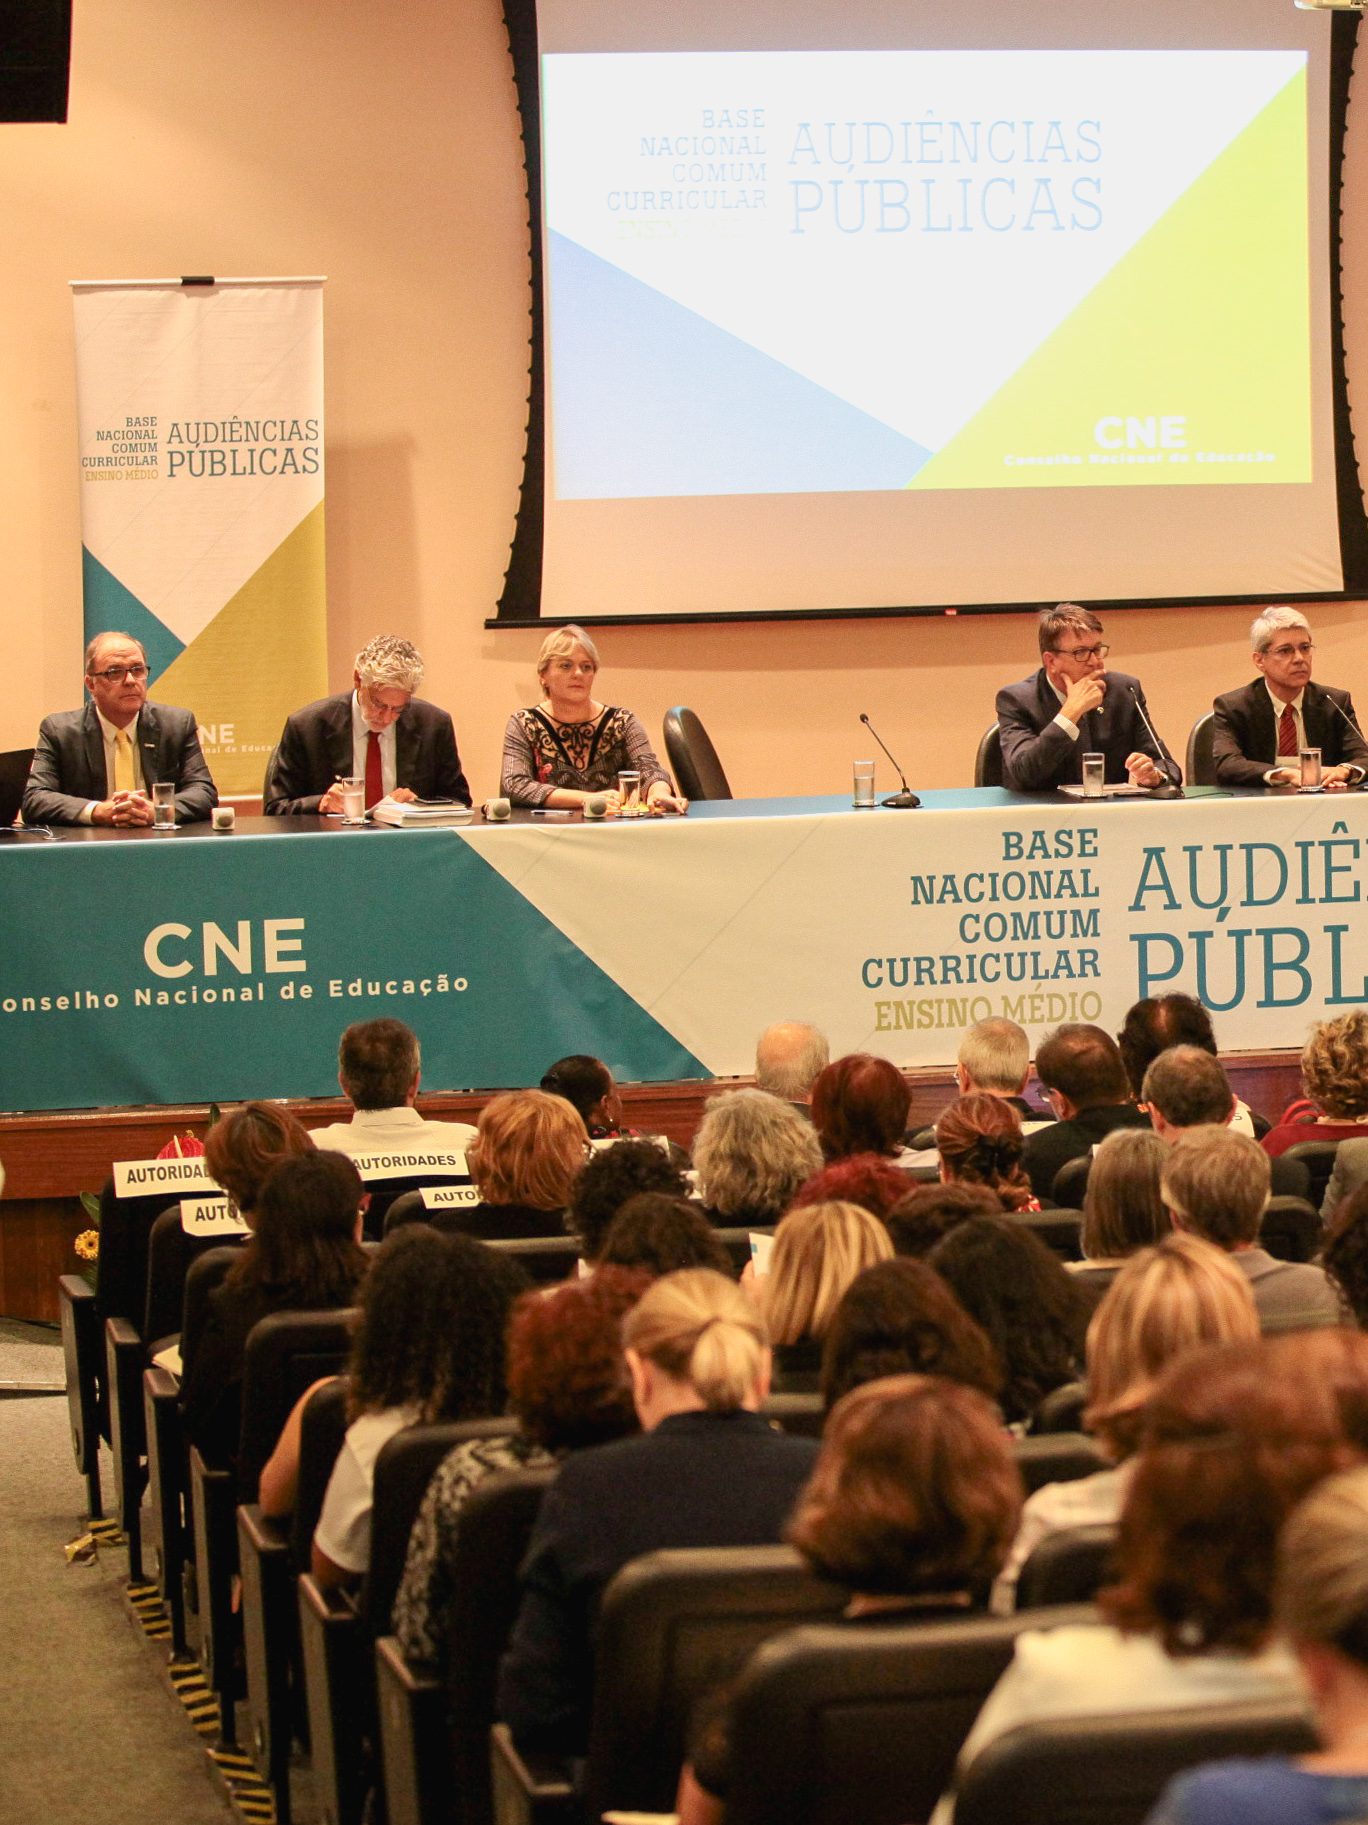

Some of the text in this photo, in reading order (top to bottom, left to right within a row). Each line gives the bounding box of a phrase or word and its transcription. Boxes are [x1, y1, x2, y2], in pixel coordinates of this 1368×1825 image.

[702, 108, 766, 129] BASE
[640, 136, 767, 157] NACIONAL
[788, 110, 1103, 166] AUDIÊNCIAS
[672, 163, 768, 183] COMUM
[606, 189, 768, 212] CURRICULAR
[789, 164, 1104, 234] PÚBLICAS
[96, 430, 158, 441] NACIONAL
[126, 417, 157, 427] BASE
[167, 416, 319, 444] AUDIÊNCIAS
[1094, 416, 1187, 449] CNE
[82, 455, 158, 467] CURRICULAR
[112, 443, 158, 453] COMUM
[167, 443, 319, 477] PÚBLICAS
[85, 467, 159, 481] ENSINO MÉDIO
[199, 724, 235, 745] NE
[1002, 828, 1099, 861] BASE
[910, 868, 1100, 905] NACIONAL
[959, 908, 1101, 943] COMUM
[143, 918, 307, 979] CNE
[861, 948, 1102, 989] CURRICULAR
[2, 974, 469, 1013] onselho Nacional de Educação
[874, 982, 1103, 1032] ENSINO MÉDIO
